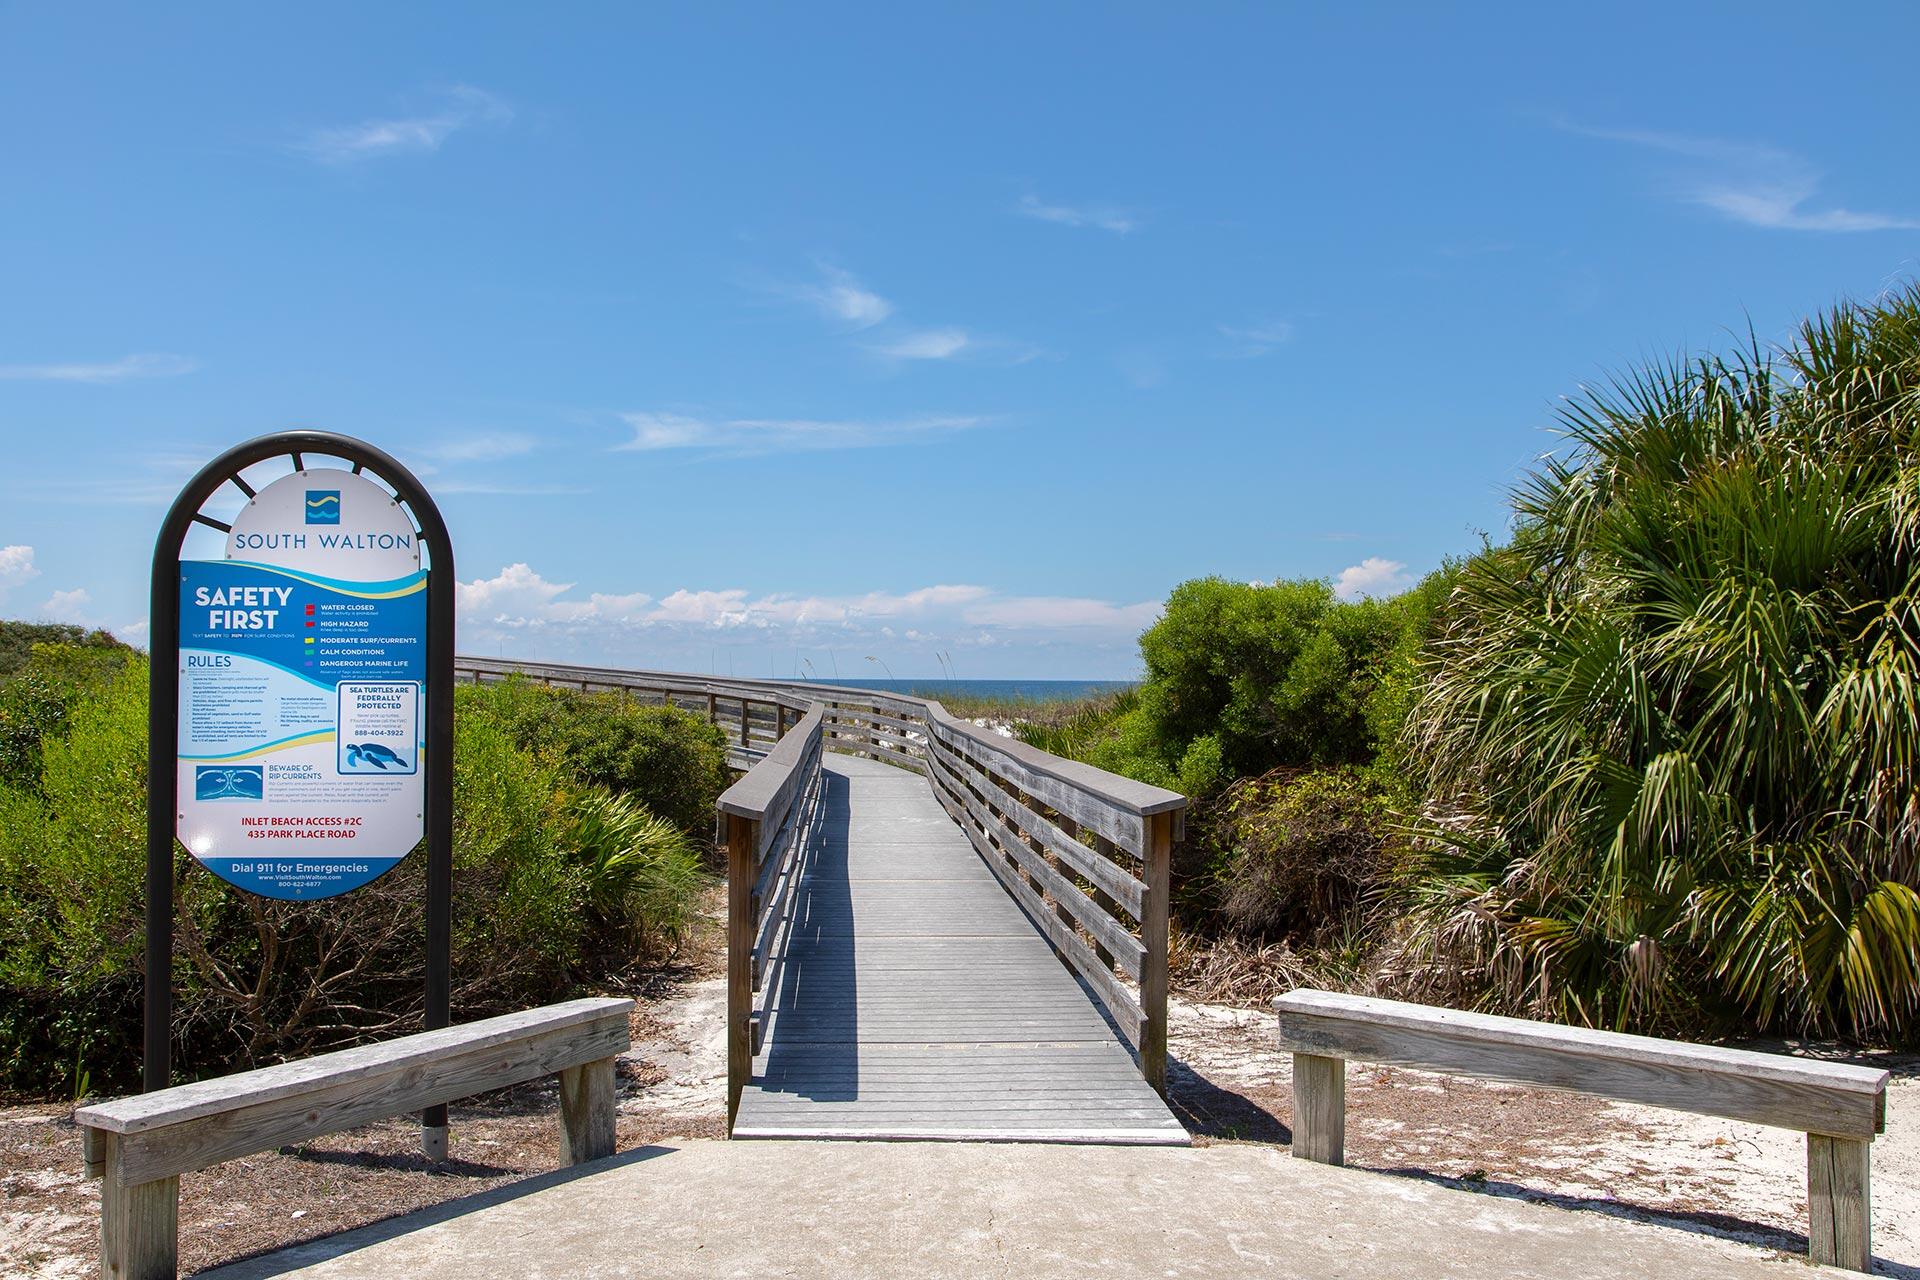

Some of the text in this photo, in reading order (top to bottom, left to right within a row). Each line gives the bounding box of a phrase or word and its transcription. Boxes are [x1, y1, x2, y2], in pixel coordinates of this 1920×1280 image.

[235, 533, 410, 549] SOUTH WALTON
[194, 586, 294, 606] SAFETY
[209, 610, 279, 630] FIRST
[188, 656, 232, 667] RULES
[242, 817, 362, 826] INLET BEACH ACCESS #2C
[247, 830, 356, 838] 435 PARK PLACE ROAD
[232, 863, 369, 874] Dial 911 for Emergencies
